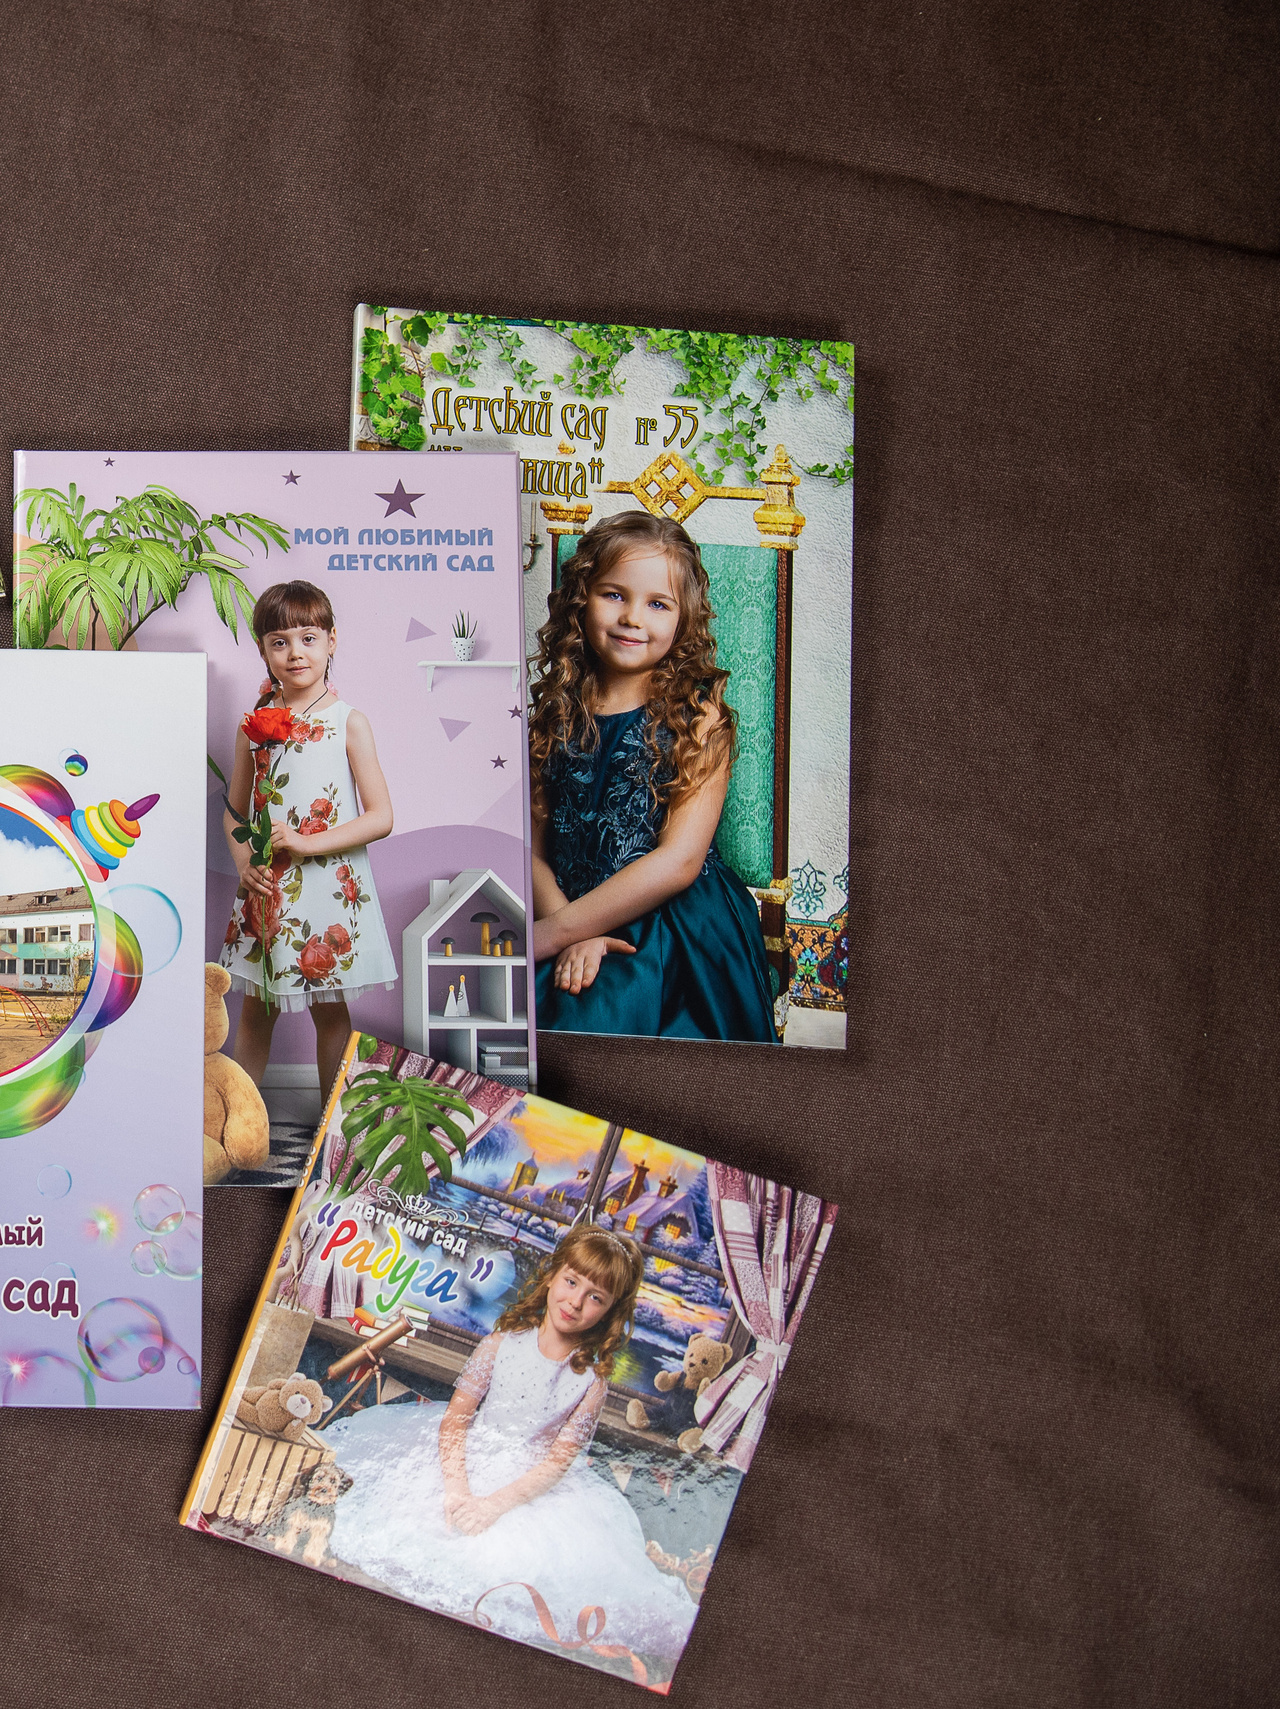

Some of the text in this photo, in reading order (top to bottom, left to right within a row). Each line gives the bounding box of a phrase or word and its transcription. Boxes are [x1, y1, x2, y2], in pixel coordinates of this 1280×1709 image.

[429, 386, 553, 437] Детский
[560, 403, 609, 452] сад
[294, 526, 494, 546] МОЙ ЛЮБИМЫЙ
[327, 553, 495, 572] ДЕТСКИЙ САД
[351, 1200, 468, 1258] детский сад
[2, 1278, 79, 1318] сад
